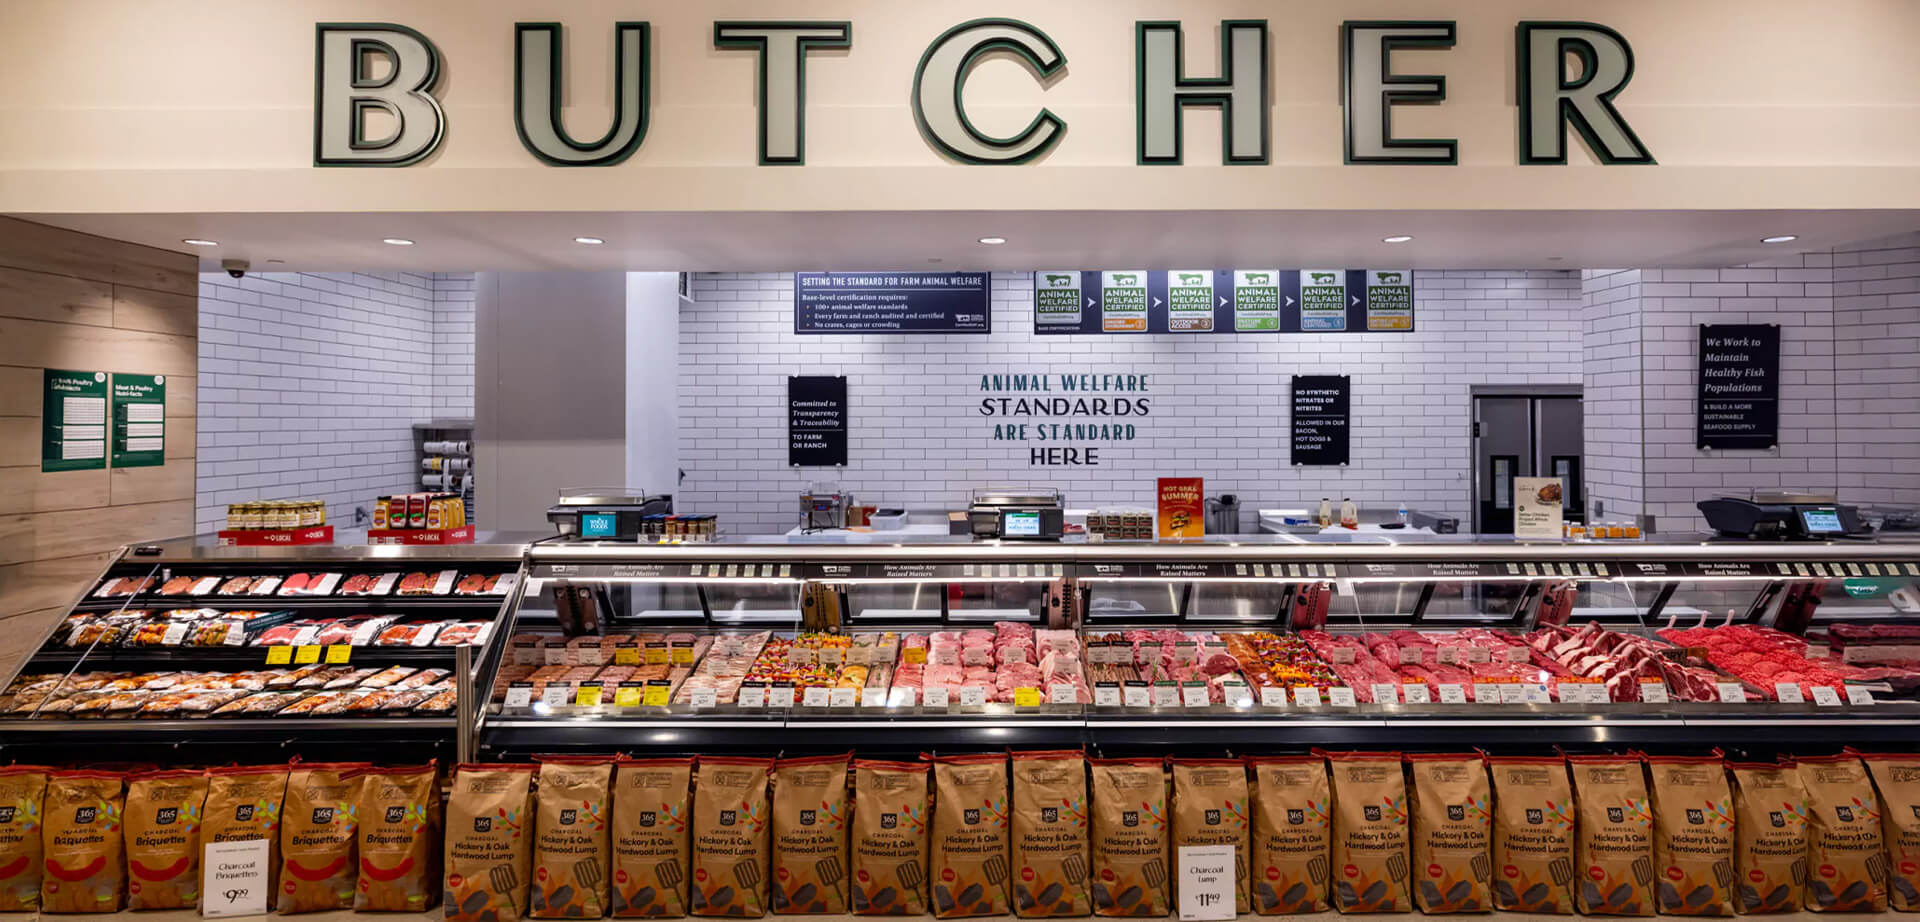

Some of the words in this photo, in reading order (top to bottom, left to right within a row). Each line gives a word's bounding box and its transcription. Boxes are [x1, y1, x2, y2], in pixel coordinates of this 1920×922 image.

[313, 18, 1658, 167] BUTCHER
[802, 276, 831, 286] SETTING
[832, 276, 846, 286] THE
[847, 276, 882, 286] STANDARD
[884, 276, 898, 286] FOR
[900, 276, 920, 286] FARM
[922, 276, 948, 286] ANIMAL
[951, 276, 982, 286] WELFARE
[1039, 290, 1078, 298] ANIMAL
[1238, 288, 1276, 296] ANIMAL
[878, 294, 908, 302] requires:
[1706, 338, 1720, 346] We
[1724, 337, 1749, 346] Work
[1752, 338, 1761, 346] to
[1704, 353, 1750, 362] Maintain
[1704, 368, 1742, 379] Healthy
[1744, 367, 1765, 377] Fish
[980, 374, 1052, 392] ANIMAL
[1061, 374, 1149, 392] WELFARE
[1704, 382, 1762, 394] Populations
[978, 398, 1150, 416] STANDARDS
[793, 410, 840, 418] Transparency
[800, 419, 840, 427] Traceability
[994, 423, 1028, 441] ARE
[1037, 423, 1136, 441] STANDARD
[1030, 447, 1099, 466] HERE
[1161, 492, 1200, 501] SUMMER
[78, 810, 94, 818] 365
[159, 810, 176, 818] 365
[315, 810, 331, 818] 365
[387, 809, 403, 818] 365
[136, 835, 186, 846] Briquettes
[292, 836, 345, 846] Briquettes
[366, 834, 413, 845] Briquettes
[1350, 832, 1378, 841] Hickory
[1509, 834, 1540, 844] Hickory
[1550, 836, 1566, 844] Oak
[455, 842, 484, 851] Hickory
[619, 838, 648, 847] Hickory
[658, 838, 673, 846] Oak
[862, 839, 890, 848] Hickory
[900, 840, 915, 848] Oak
[1345, 841, 1385, 850] Hardwood
[616, 847, 653, 855] Hardwood
[656, 847, 678, 855] Lump
[1504, 842, 1547, 853] Hardwood
[451, 851, 489, 860] Hardwood
[491, 853, 515, 861] Lump
[858, 848, 896, 857] Hardwood
[218, 861, 256, 871] Charcoal
[1190, 866, 1224, 874] Charcoal
[216, 871, 258, 880] Briquettes
[1198, 876, 1218, 884] Lump
